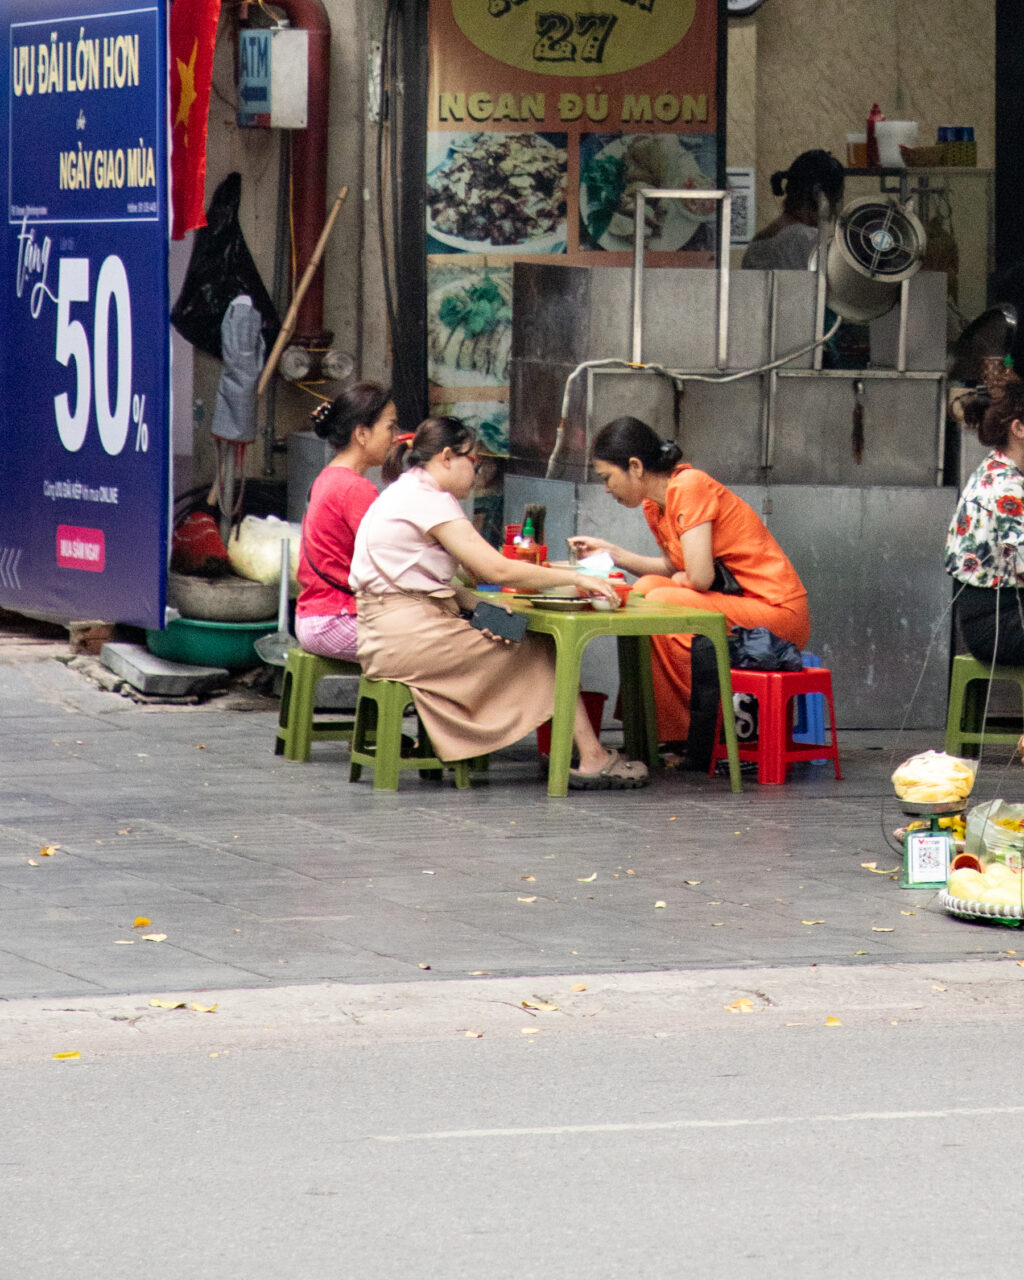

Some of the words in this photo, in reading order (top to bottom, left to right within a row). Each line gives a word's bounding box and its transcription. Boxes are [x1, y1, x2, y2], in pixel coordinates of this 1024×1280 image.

[14, 46, 36, 97] ƯU
[38, 31, 64, 95] ĐÃI
[67, 26, 99, 93] LỚN
[103, 34, 139, 90] HƠN
[241, 36, 269, 78] ATM
[531, 10, 617, 64] 27
[439, 92, 546, 123] NGAN
[557, 86, 610, 123] ĐỦ
[59, 141, 93, 190] NGÀY
[94, 150, 125, 189] GIAO
[127, 137, 156, 188] MÙA
